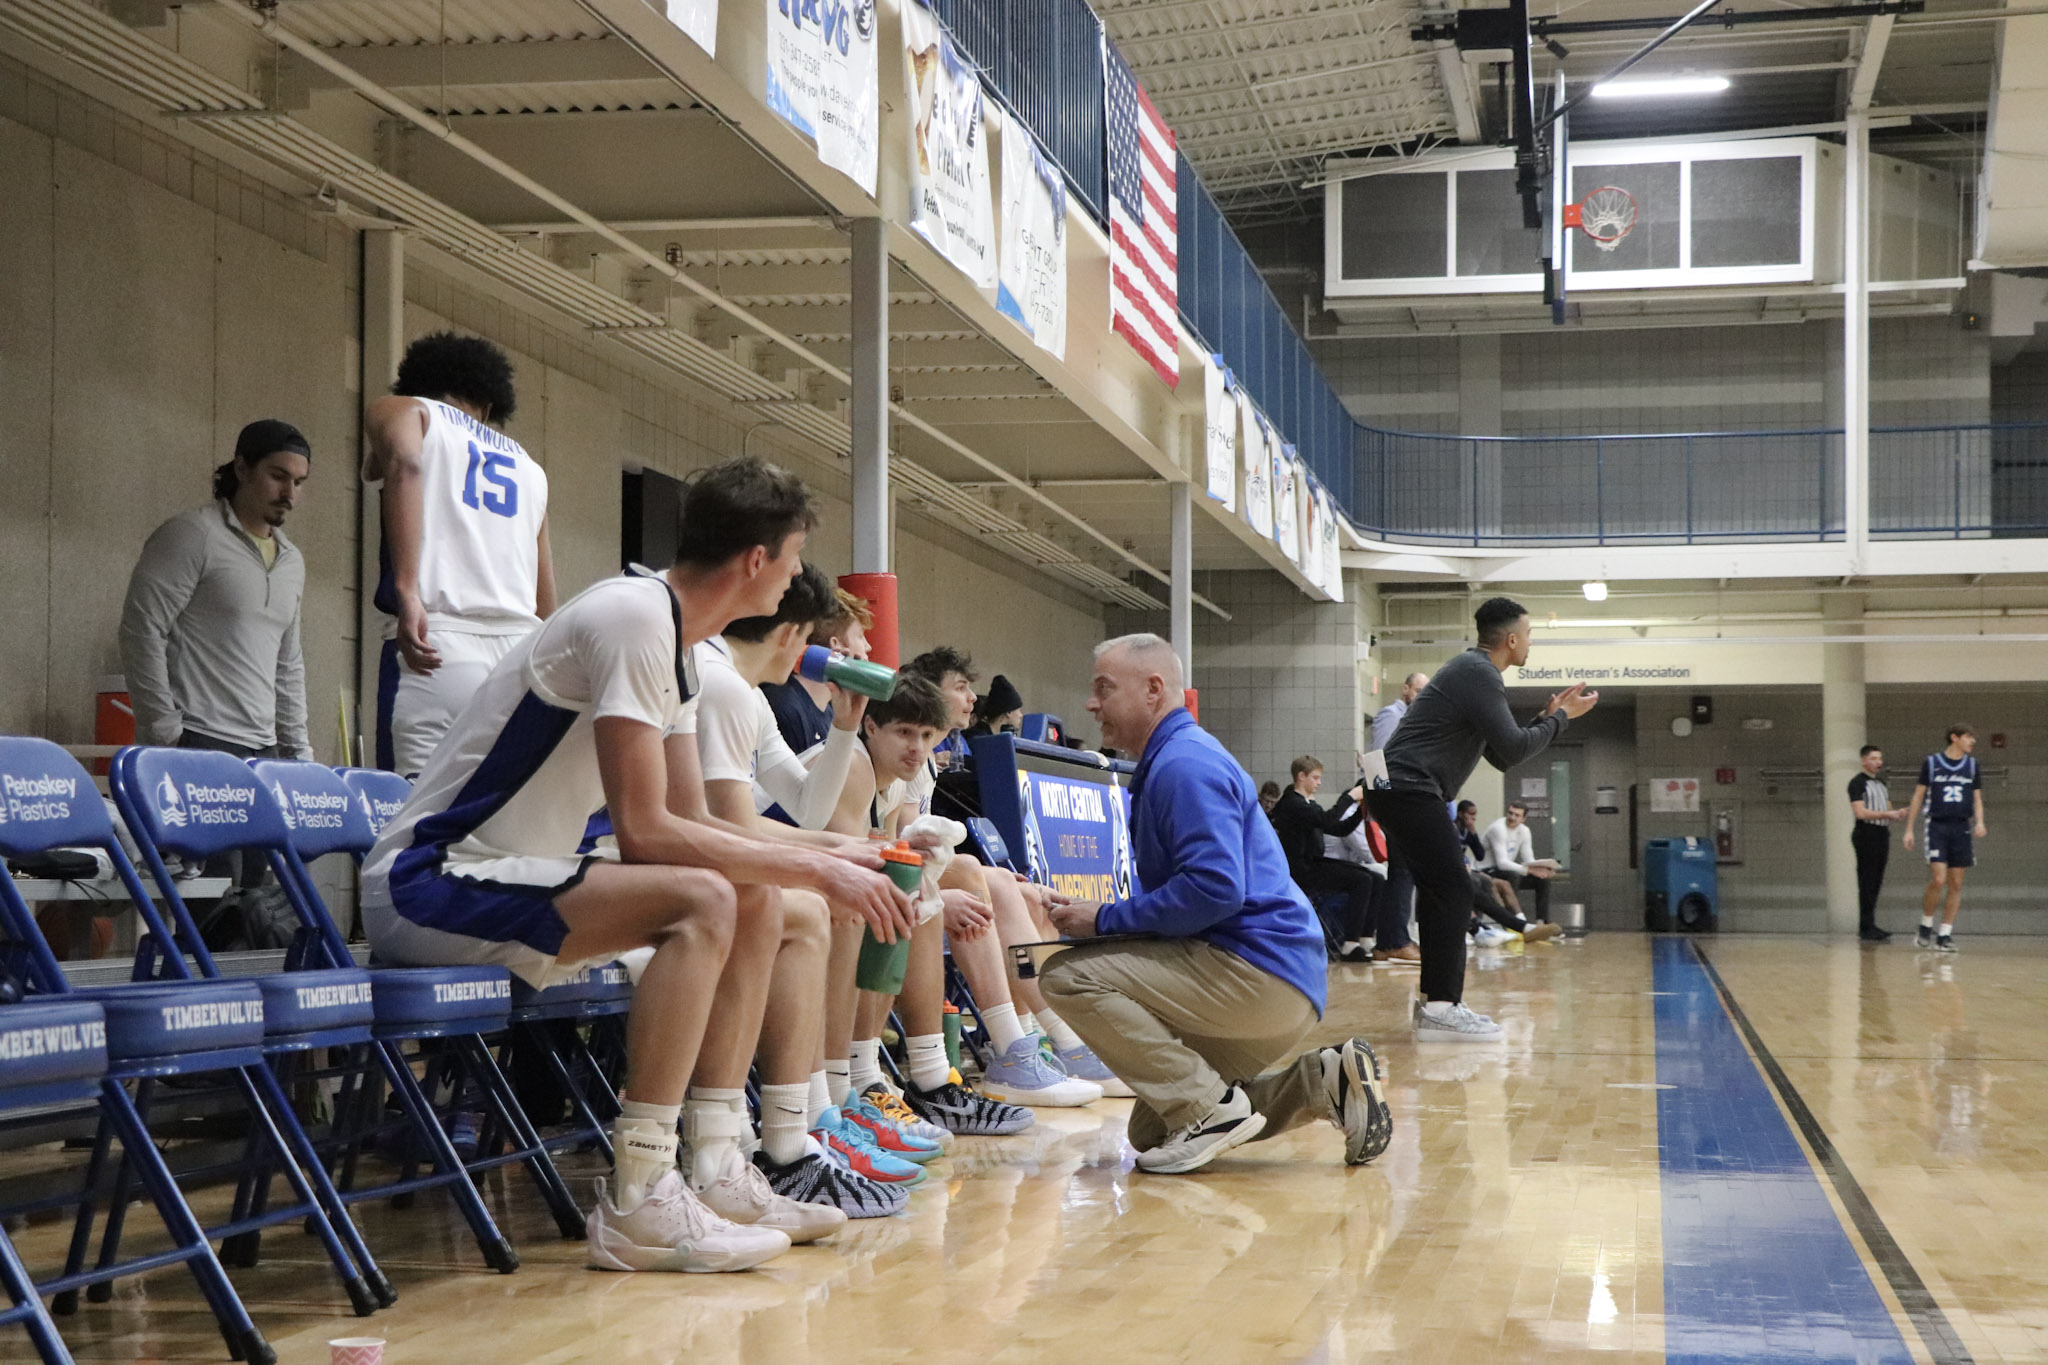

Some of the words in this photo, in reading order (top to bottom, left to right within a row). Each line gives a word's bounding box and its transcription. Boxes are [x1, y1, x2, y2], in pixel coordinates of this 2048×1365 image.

[462, 440, 518, 518] 15
[1518, 666, 1562, 680] Student
[1565, 666, 1620, 679] Veteran's
[1623, 665, 1691, 679] Association
[3, 774, 77, 799] Petoskey
[185, 782, 256, 806] Petoskey
[1943, 785, 1963, 803] 25
[9, 797, 71, 822] Plastics
[291, 790, 349, 812] Petoskey
[374, 798, 405, 816] Petosk
[1039, 780, 1071, 820] NORTH
[1069, 785, 1106, 823] CENTRAL
[190, 804, 249, 825] Plastics
[297, 809, 343, 828] Plastics
[1058, 834, 1078, 858] HOME
[1077, 835, 1085, 859] OF
[1085, 835, 1099, 859] THE
